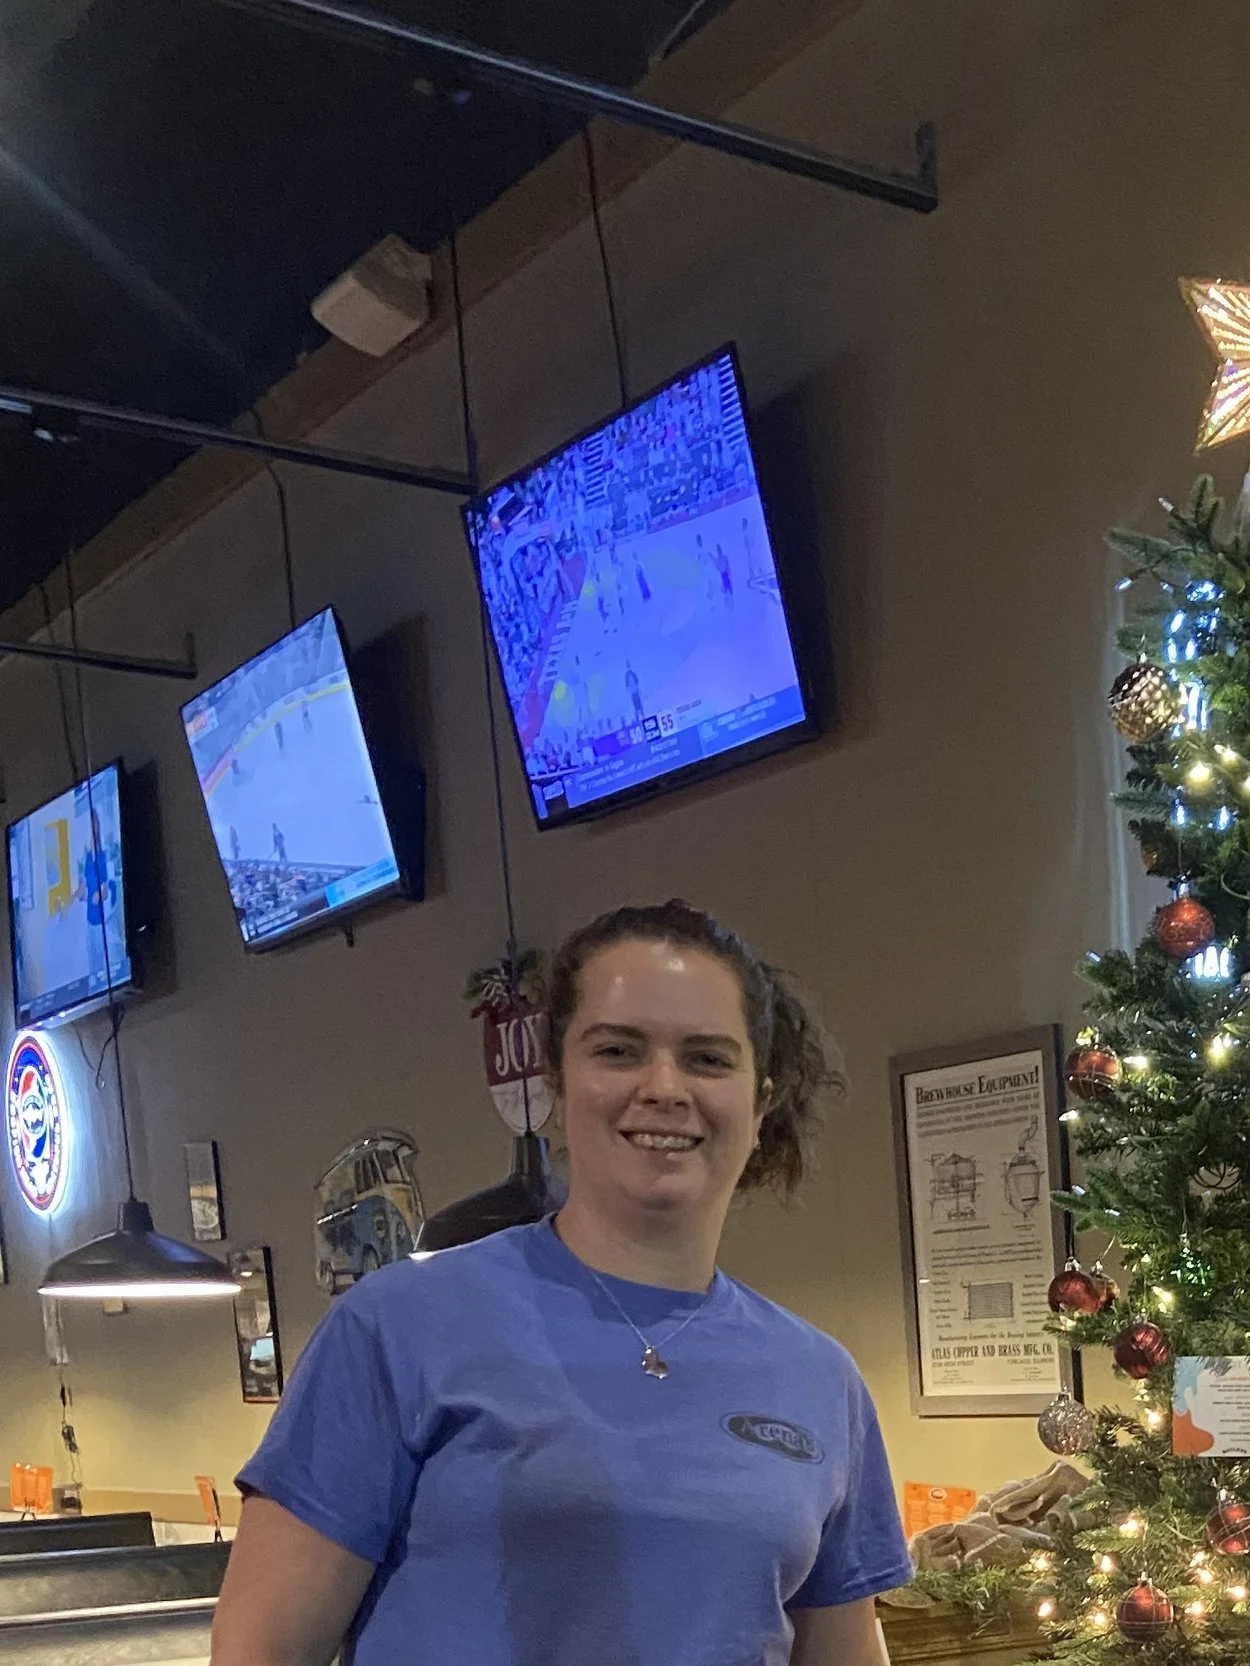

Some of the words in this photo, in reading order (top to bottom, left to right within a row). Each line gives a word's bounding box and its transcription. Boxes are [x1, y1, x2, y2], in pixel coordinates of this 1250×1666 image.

[495, 1012, 545, 1076] JOY
[915, 1082, 976, 1104] BREWHOUSE
[932, 1347, 951, 1360] ATLAS
[953, 1345, 979, 1359] COPPER
[982, 1344, 996, 1356] AND
[998, 1344, 1020, 1356] BRASS
